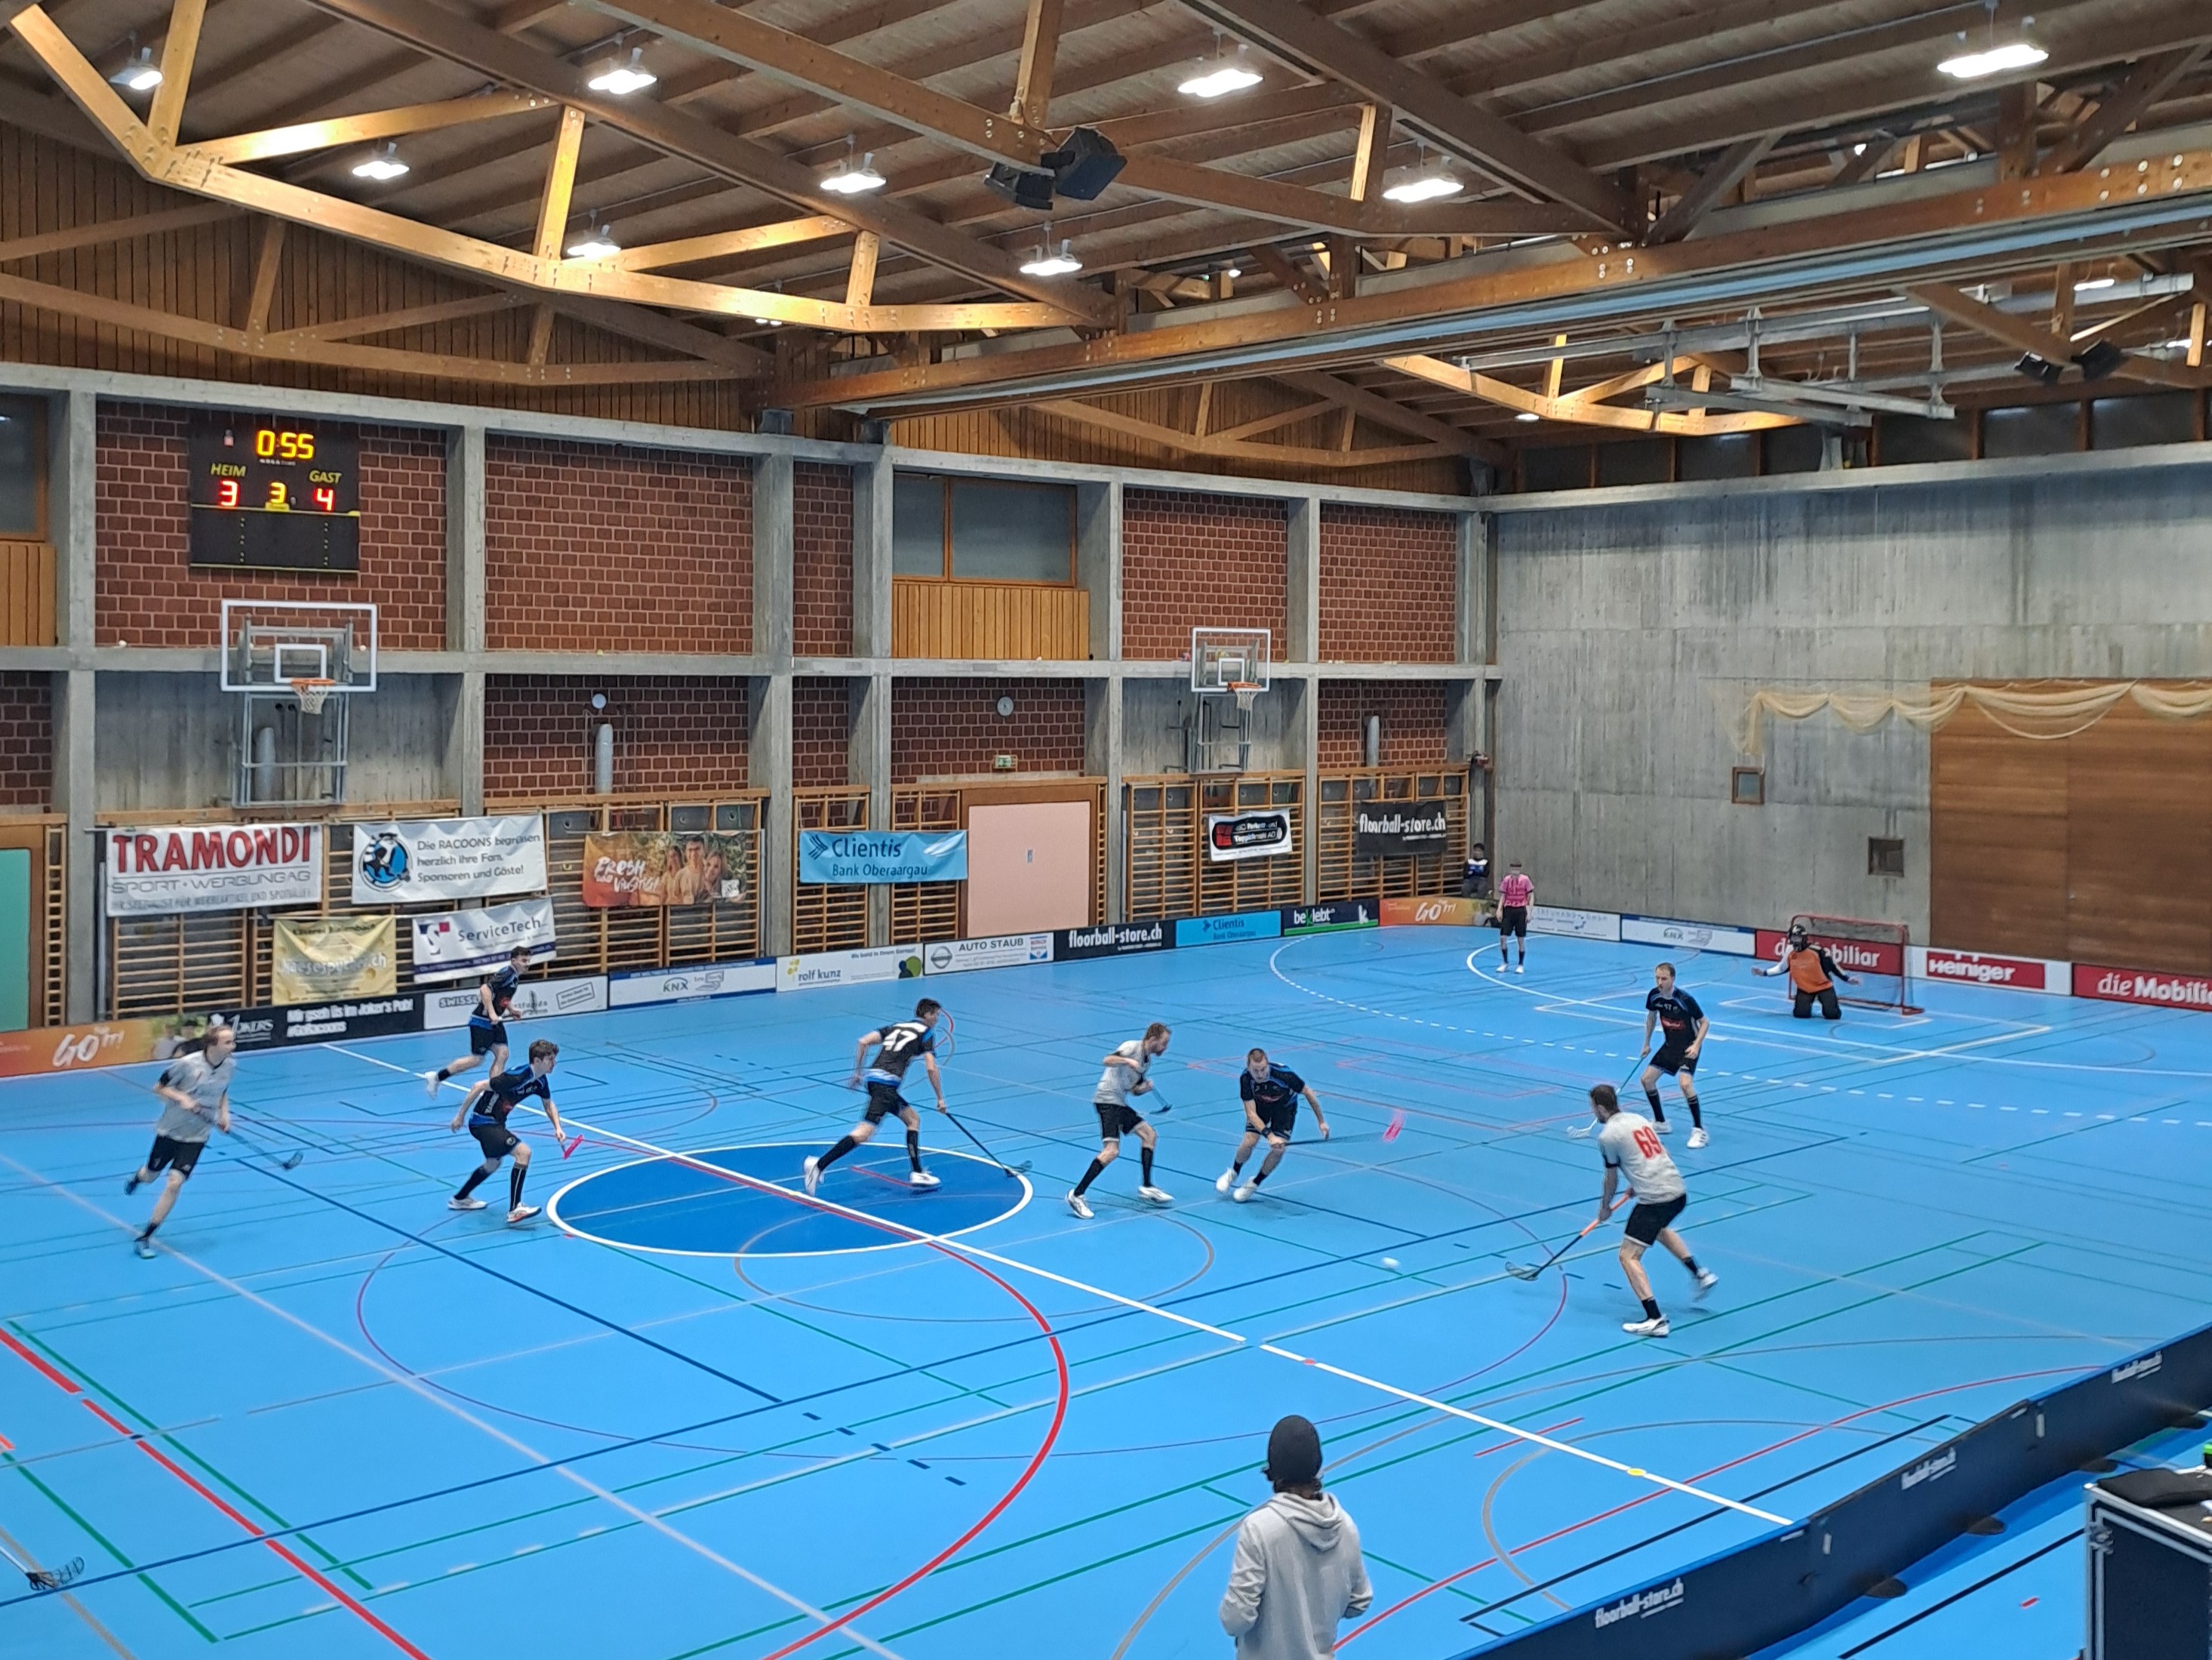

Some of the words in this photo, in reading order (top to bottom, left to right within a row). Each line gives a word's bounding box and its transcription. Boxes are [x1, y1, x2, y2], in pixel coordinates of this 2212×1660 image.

[210, 463, 248, 477] HEIM
[309, 470, 343, 484] GAST
[219, 480, 239, 507] 3
[269, 482, 287, 504] 3
[315, 488, 334, 511] 4
[1359, 812, 1446, 833] floorball-store.ch
[112, 826, 311, 873] TRAMONDI
[417, 840, 435, 851] Die
[438, 837, 491, 849] RACOONS
[832, 837, 902, 858] Clientis
[417, 855, 457, 867] herzlich
[459, 855, 478, 864] Ihre
[832, 864, 860, 876] Bank
[863, 864, 928, 879] Oberaargau
[112, 879, 180, 894] SPORT
[191, 872, 286, 889] WERBUNG
[287, 870, 311, 882] AG
[417, 871, 471, 883] Sponsoren
[473, 868, 492, 879] und
[458, 916, 542, 942] ServiceTech
[1213, 917, 1244, 930] Clientis
[958, 941, 987, 952] AUTO
[990, 938, 1024, 949] STAUB
[1069, 922, 1162, 948] floorball-store.ch
[798, 969, 816, 981] rolf
[817, 969, 841, 979] kunz
[2097, 972, 2131, 995] die
[663, 982, 688, 993] KNX
[1632, 1125, 1663, 1160] 69
